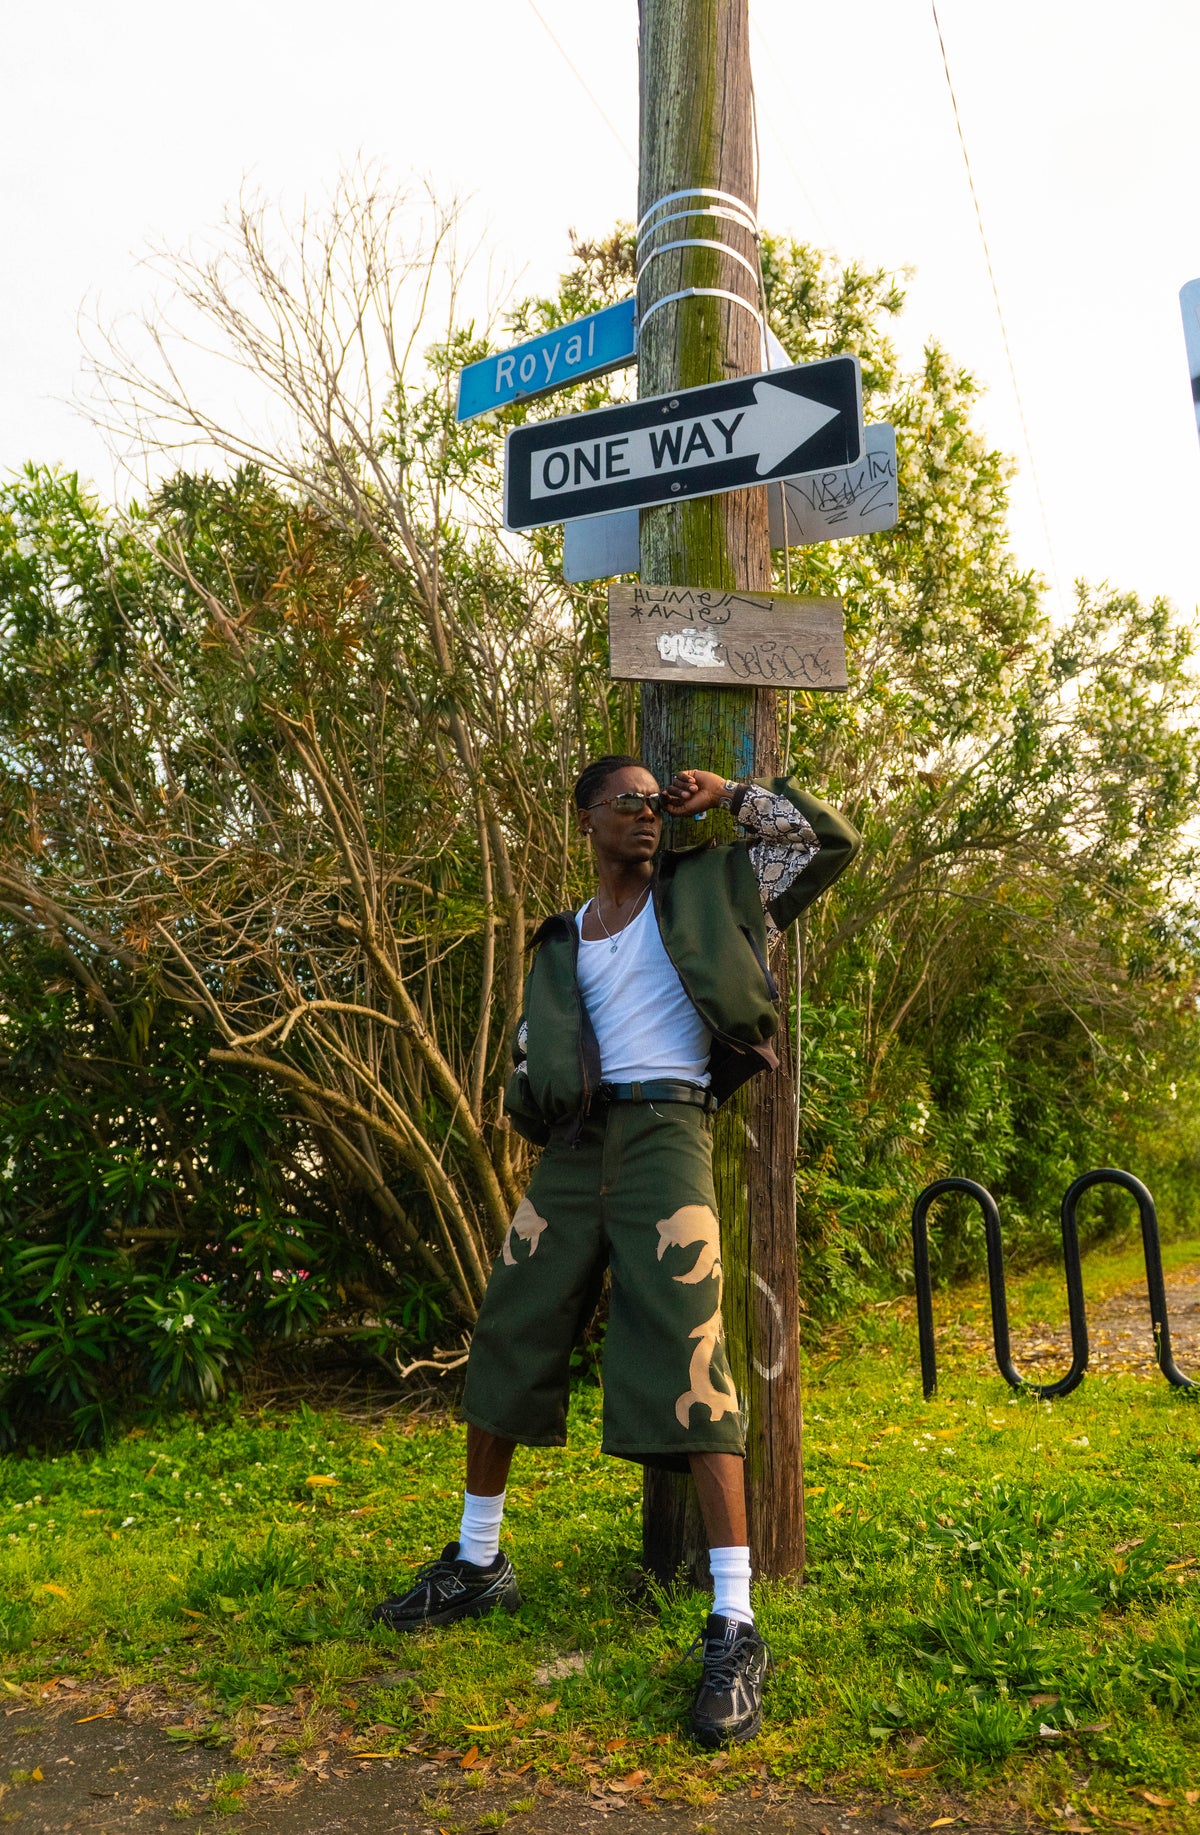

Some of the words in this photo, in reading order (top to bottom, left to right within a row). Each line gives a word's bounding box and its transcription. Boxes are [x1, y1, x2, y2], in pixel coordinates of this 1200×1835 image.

[495, 320, 595, 393] Royal
[542, 437, 631, 490] ONE
[648, 411, 746, 470] WAY
